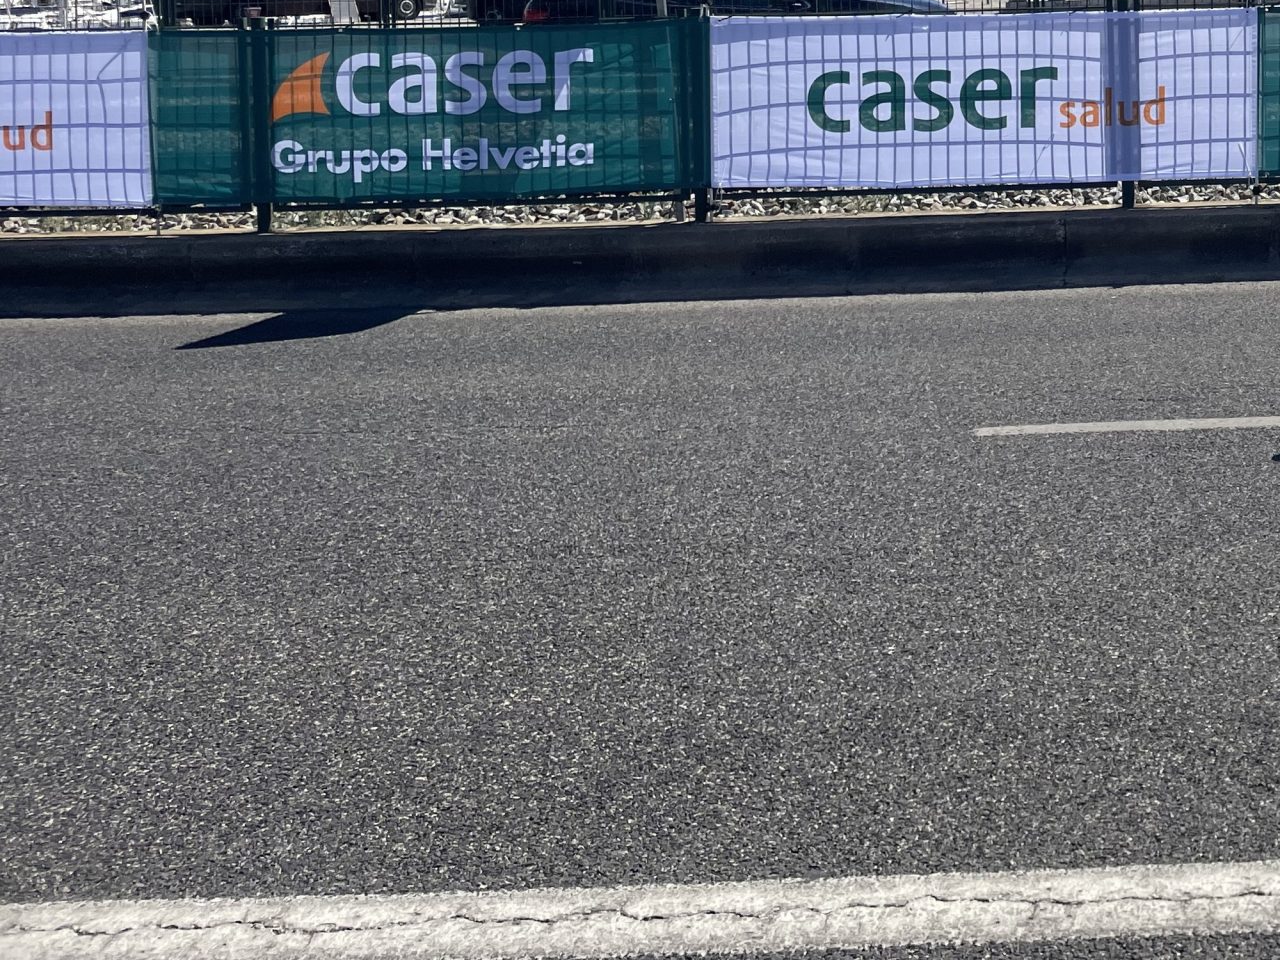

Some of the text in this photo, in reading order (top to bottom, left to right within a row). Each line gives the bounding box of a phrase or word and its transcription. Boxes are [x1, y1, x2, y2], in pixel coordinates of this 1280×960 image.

[336, 48, 594, 116] caser
[807, 66, 1165, 133] caser salud
[271, 134, 594, 183] Grupo Helvetia
